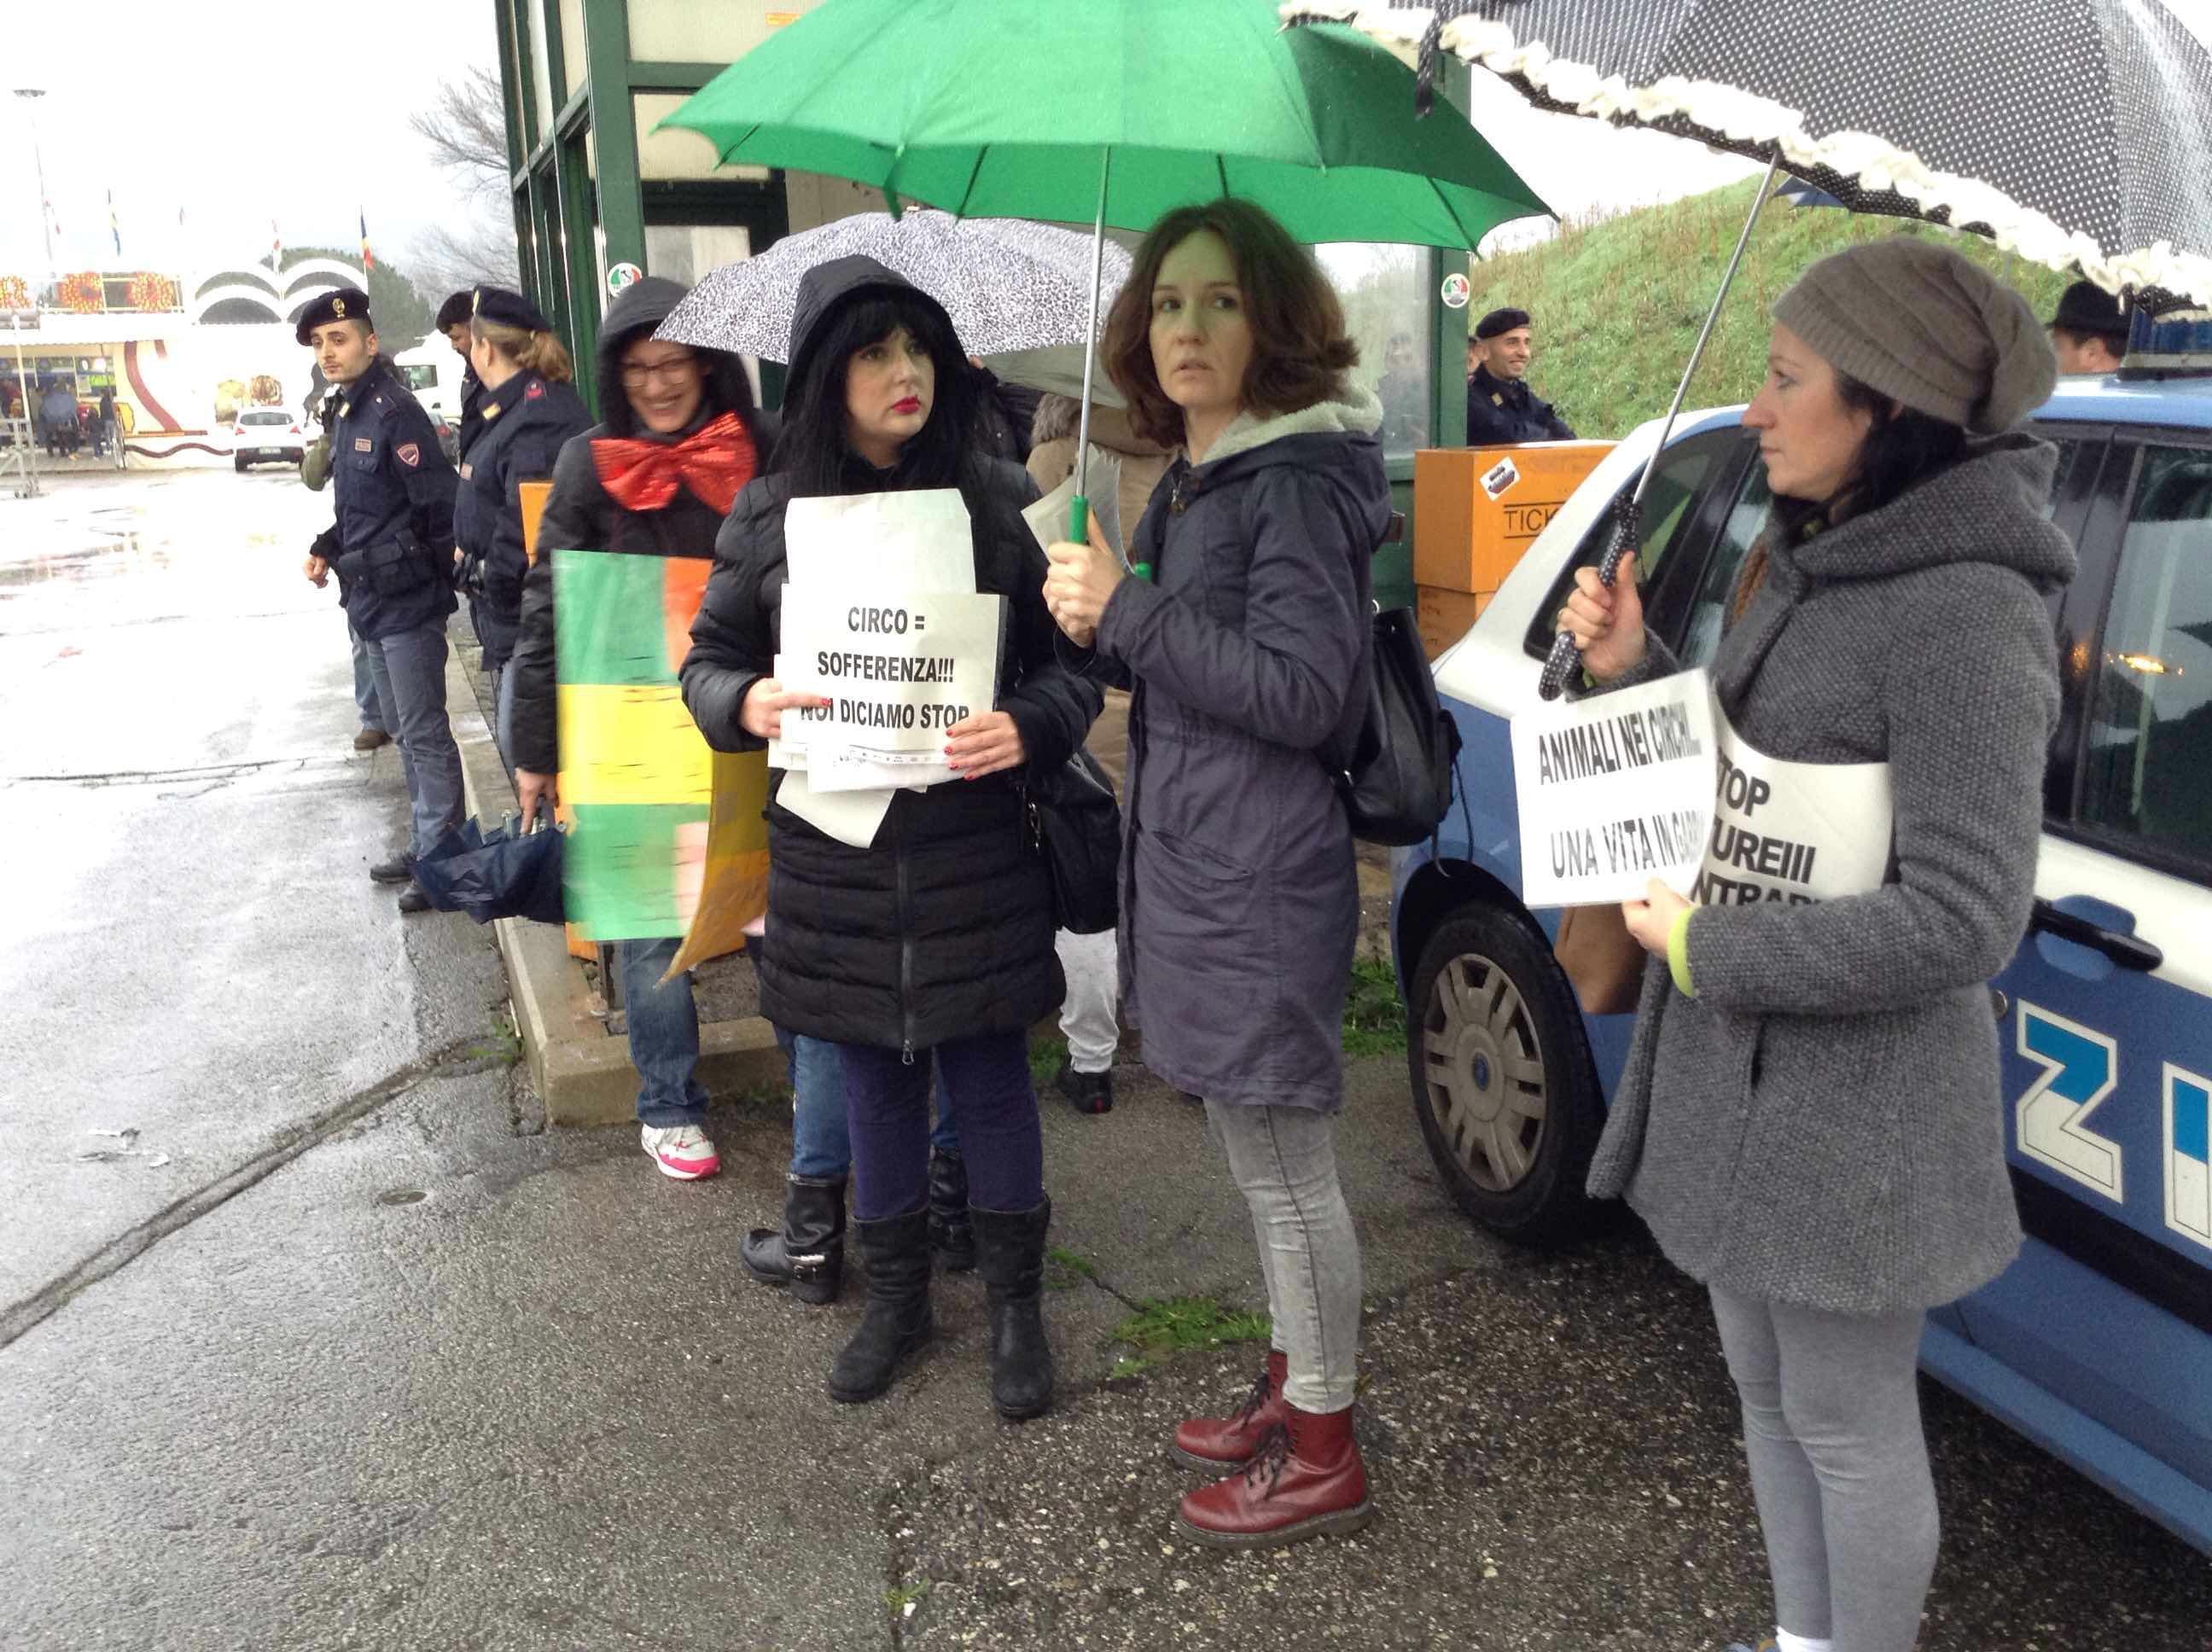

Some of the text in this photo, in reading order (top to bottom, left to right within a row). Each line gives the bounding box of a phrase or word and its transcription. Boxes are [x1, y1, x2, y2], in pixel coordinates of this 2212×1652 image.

[847, 607, 925, 635] CIRCO =
[817, 650, 955, 683] SOFFERENZA!!!
[840, 698, 915, 729] DICIAMO
[1539, 717, 1622, 785] ANIMALI
[1617, 711, 1651, 768] NEI
[1551, 828, 1599, 879] UNA
[1603, 817, 1656, 874] VITA
[1652, 814, 1677, 867] IN
